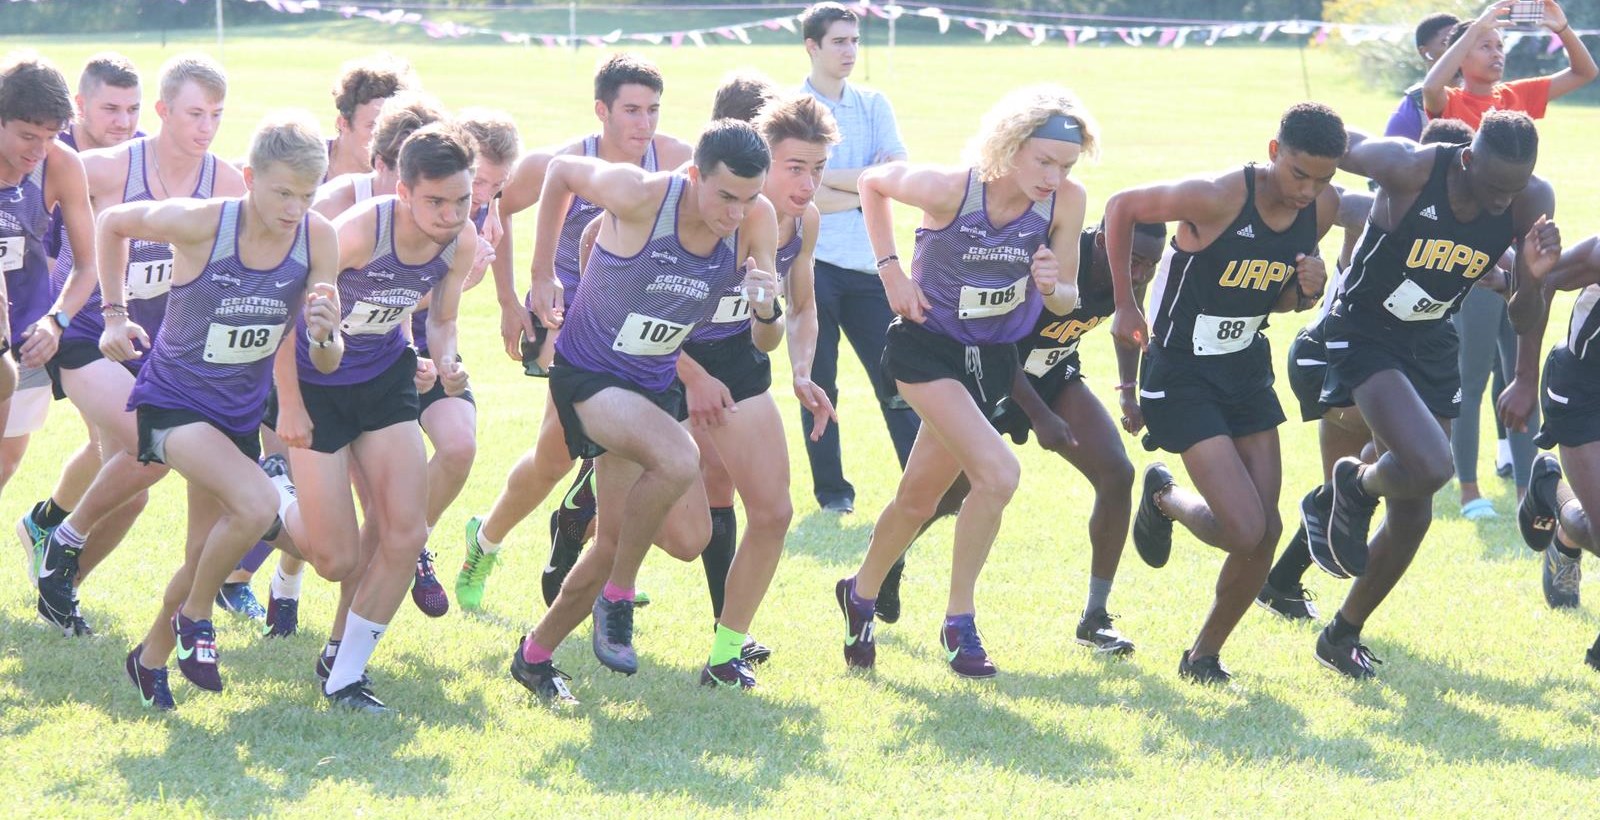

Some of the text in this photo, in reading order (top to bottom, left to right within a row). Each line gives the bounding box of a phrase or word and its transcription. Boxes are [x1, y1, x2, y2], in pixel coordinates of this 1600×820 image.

[961, 252, 1030, 263] ARKANSAS
[967, 245, 1029, 257] CENTRAL
[1406, 238, 1490, 279] UAPB
[655, 274, 710, 293] CENTRAL
[220, 296, 287, 308] CENTRAL
[977, 284, 1016, 306] 108
[215, 304, 289, 316] ARKANSAS
[1412, 297, 1444, 314] 90
[365, 306, 404, 324] 112
[227, 327, 271, 349] 103
[639, 319, 683, 343] 107
[1216, 320, 1246, 340] 88
